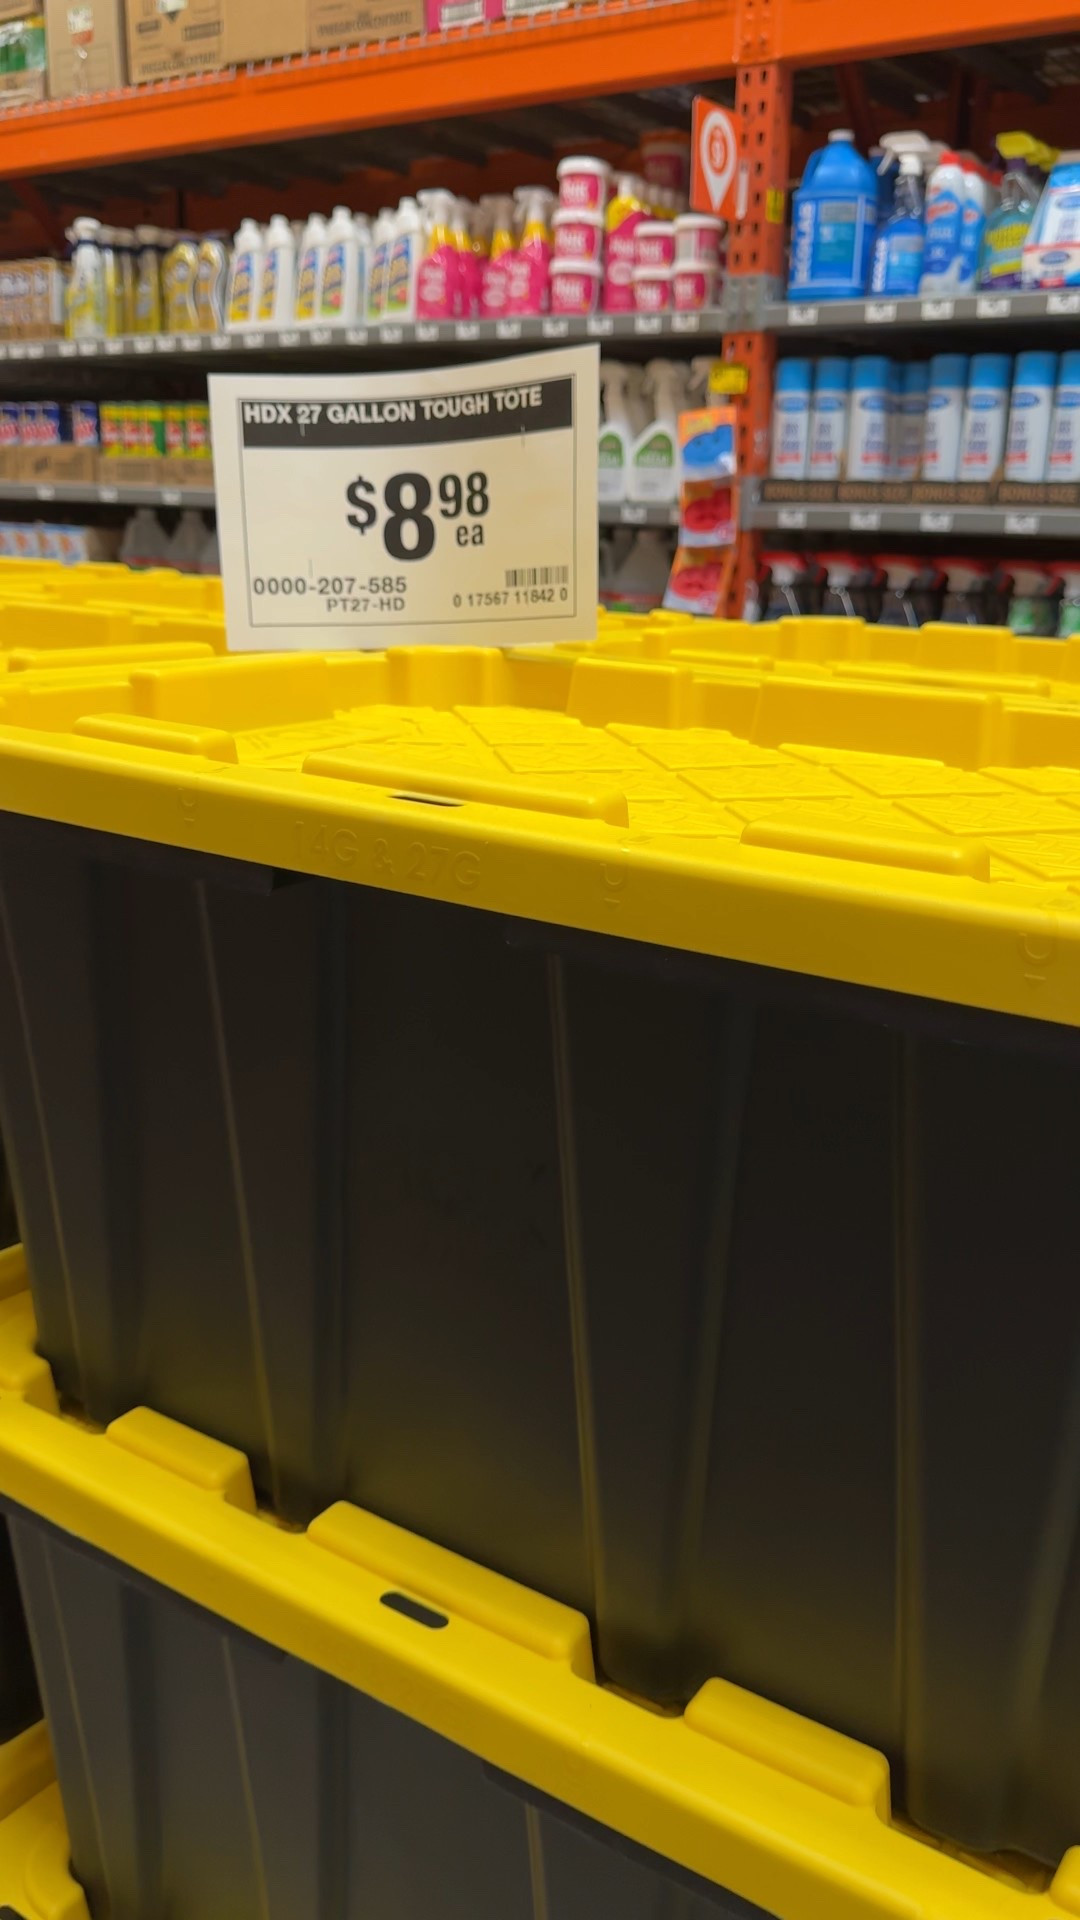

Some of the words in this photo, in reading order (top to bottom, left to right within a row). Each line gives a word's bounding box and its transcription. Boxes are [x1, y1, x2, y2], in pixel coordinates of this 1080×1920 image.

[244, 402, 293, 425] HDX
[297, 403, 322, 425] 27
[327, 400, 415, 424] GALLON
[421, 391, 490, 420] TOUGH
[494, 385, 542, 412] TOTE
[456, 524, 485, 546] ea
[253, 576, 407, 596] 0000-207-585
[326, 597, 406, 613] PT27-HD
[453, 594, 462, 608] 0
[468, 591, 509, 607] 17567
[515, 589, 555, 605] 11842
[560, 588, 568, 602] 0
[372, 837, 395, 875] &
[407, 840, 482, 890] 27G
